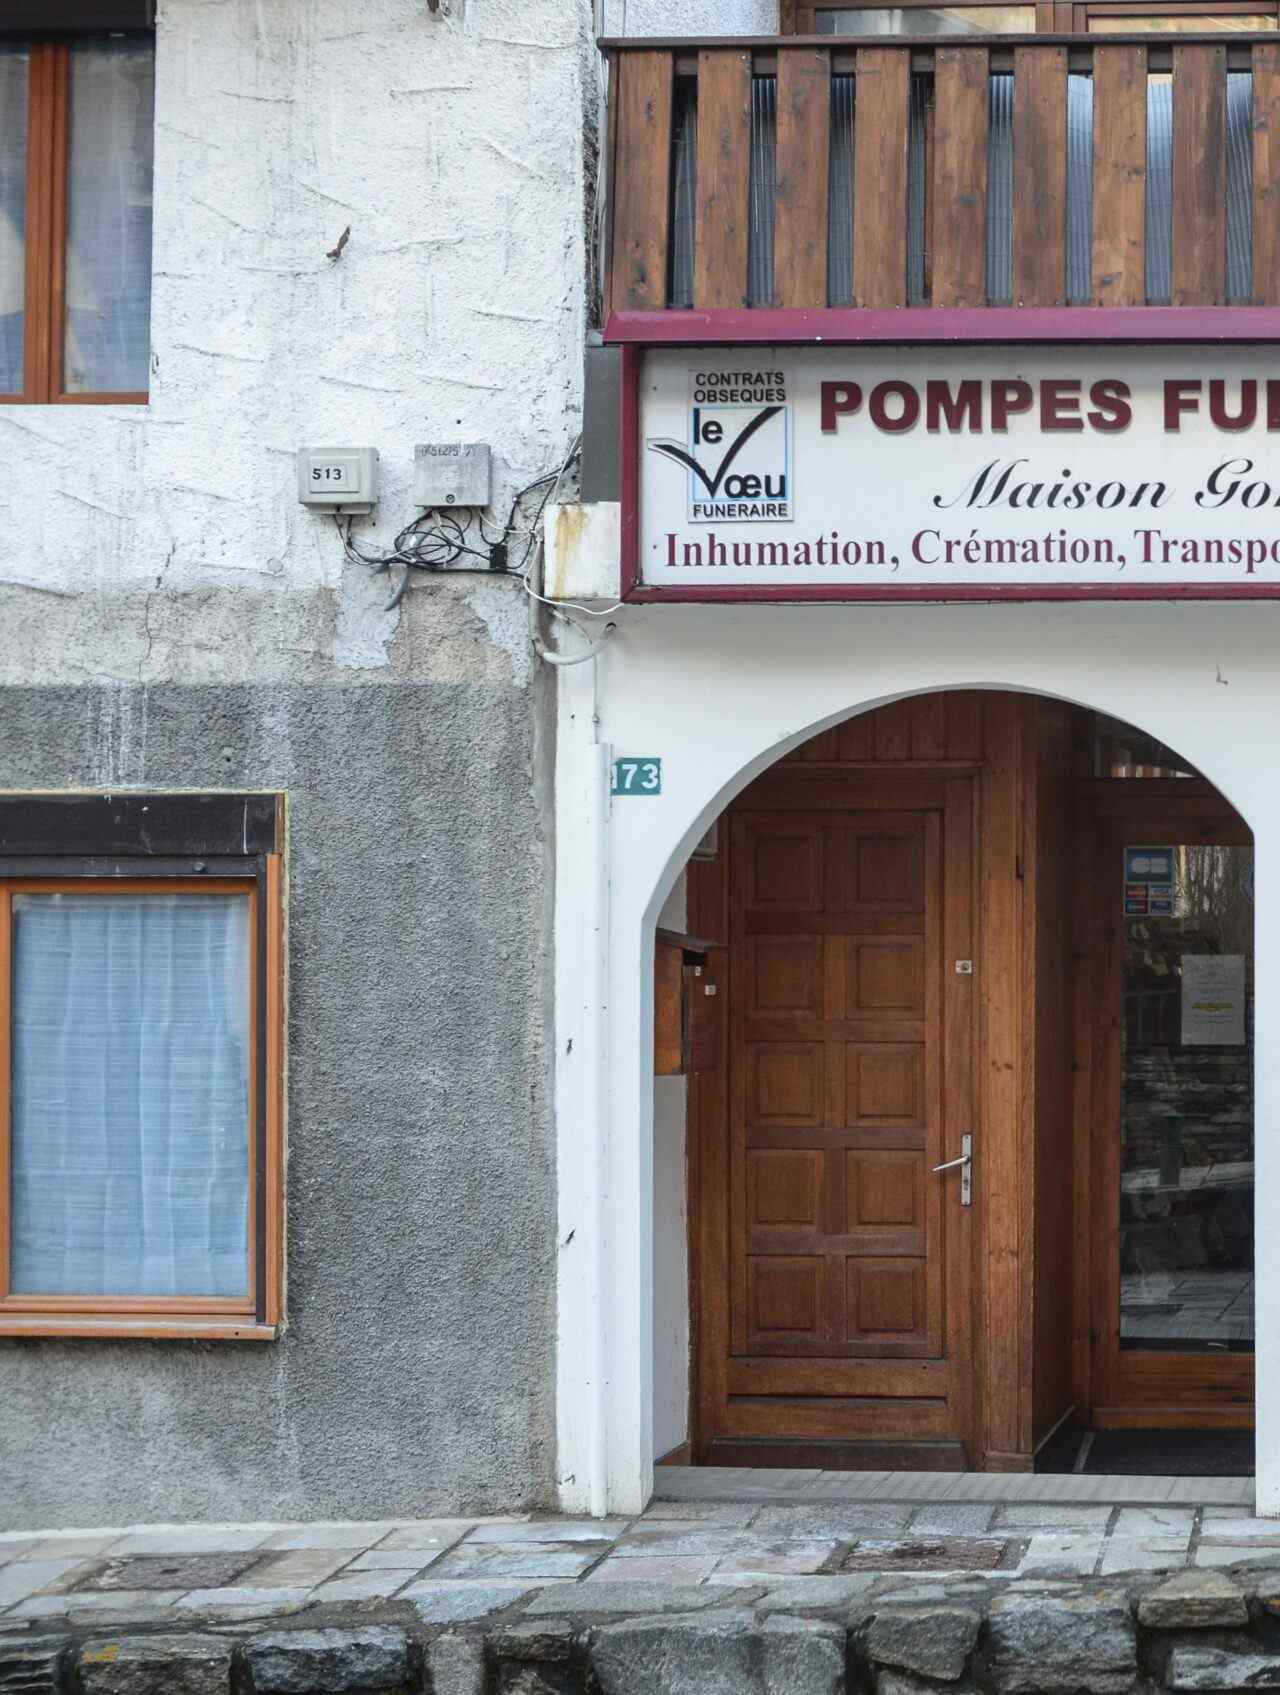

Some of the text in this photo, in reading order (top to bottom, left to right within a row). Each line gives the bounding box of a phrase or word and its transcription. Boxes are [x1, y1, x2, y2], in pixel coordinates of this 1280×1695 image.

[695, 372, 785, 387] CONTRATS
[694, 388, 787, 404] OBSEQUES
[818, 379, 1133, 434] POMPES
[693, 407, 723, 445] le
[312, 468, 342, 481] 513
[934, 458, 1173, 509] Maison
[693, 504, 788, 518] FUNERAIRE
[665, 531, 900, 571] Inhumation,
[911, 529, 1126, 571] Crémation,
